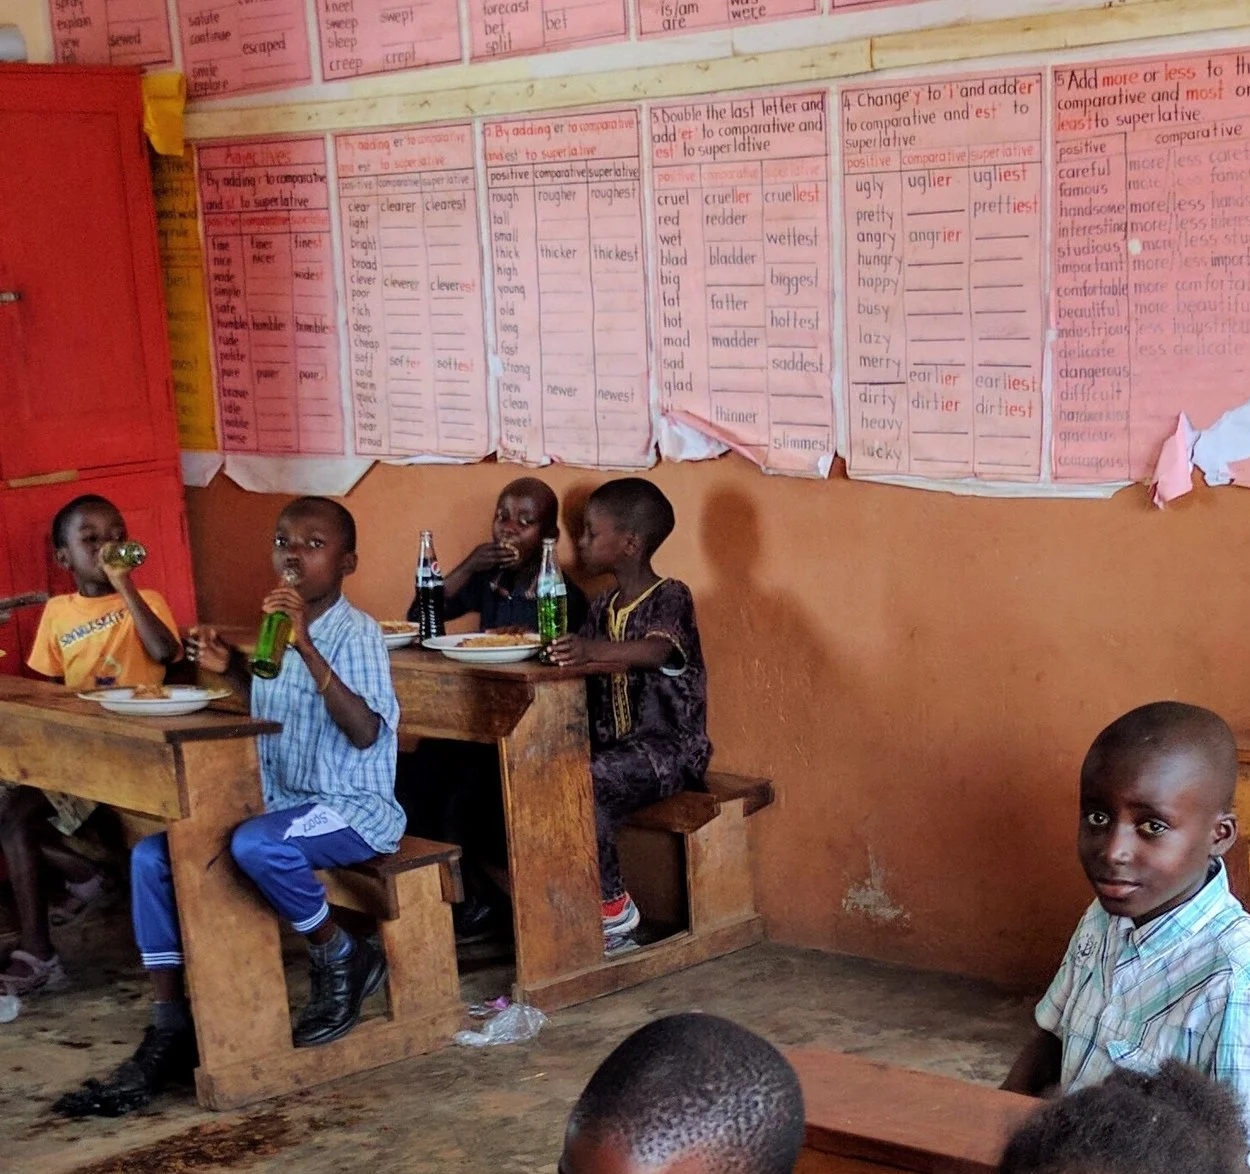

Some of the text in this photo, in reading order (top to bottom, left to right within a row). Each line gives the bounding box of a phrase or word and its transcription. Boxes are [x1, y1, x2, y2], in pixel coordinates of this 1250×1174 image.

[662, 18, 686, 31] are
[242, 33, 286, 56] escaped
[330, 57, 363, 74] creep
[1067, 70, 1098, 90] Add
[1102, 72, 1138, 87] more
[1143, 70, 1159, 83] or
[1165, 63, 1196, 81] less
[1208, 60, 1223, 78] to
[662, 95, 824, 123] Double the last letter and
[857, 91, 909, 110] Change
[928, 85, 941, 101] to
[1057, 86, 1147, 117] comparative
[1151, 83, 1180, 101] and
[1186, 80, 1224, 100] most
[653, 113, 822, 143] add to comparative and
[846, 117, 857, 132] to
[861, 109, 936, 135] comparative
[1014, 102, 1029, 114] to
[1056, 115, 1092, 131] least
[1094, 111, 1109, 128] to
[683, 138, 770, 160] to superlative
[845, 130, 916, 154] superlative
[1059, 123, 1242, 161] positive comparative
[847, 155, 891, 169] positive
[1058, 159, 1110, 179] careful
[491, 168, 529, 185] positive
[534, 164, 586, 182] comparative
[856, 164, 1027, 199] ugly uglier ugliest
[493, 182, 636, 208] rough rougher roughest
[658, 183, 820, 205] cruel crueller cruellest
[1059, 184, 1108, 197] famous
[658, 210, 748, 226] red redder
[856, 195, 1040, 230] pretty prettiest
[1060, 197, 1125, 217] handsome
[660, 227, 819, 246] wet wettest
[857, 227, 962, 251] angry angrier
[540, 244, 638, 261] thicker thickest
[710, 246, 757, 265] bladder
[858, 249, 902, 272] hungry
[660, 268, 818, 295] big biggest
[711, 294, 748, 311] fatter
[857, 299, 890, 323] busy
[664, 310, 819, 330] hot hottest
[664, 330, 759, 348] mad madder
[859, 324, 891, 353] lazy
[663, 352, 823, 373] sad saddest
[859, 355, 901, 378] merry
[665, 372, 693, 397] glad
[909, 365, 1037, 393] earlier earliest
[547, 384, 635, 403] newer newest
[859, 387, 1034, 418] dirty dirtier dirtiest
[715, 405, 758, 424] thinner
[861, 412, 903, 440] heavy
[774, 431, 830, 452] slimmest
